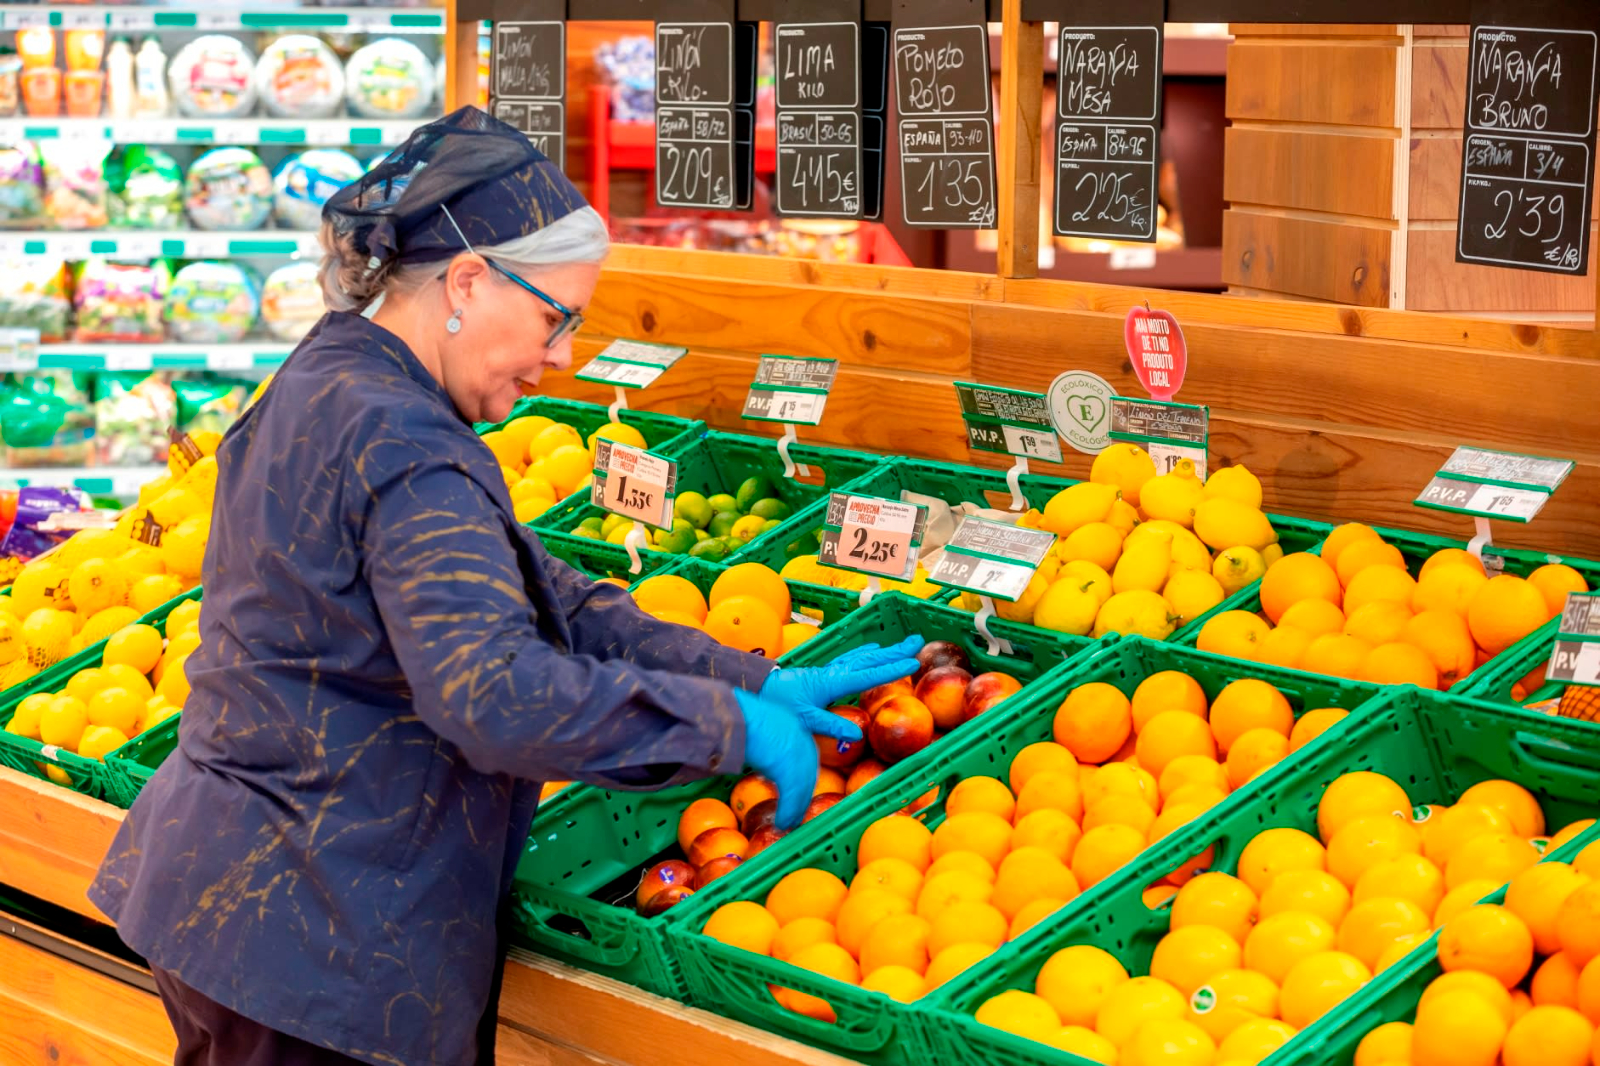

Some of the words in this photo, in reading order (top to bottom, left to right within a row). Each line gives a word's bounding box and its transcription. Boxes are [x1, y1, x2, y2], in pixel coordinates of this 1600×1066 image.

[784, 43, 835, 80] LIMA
[1064, 38, 1139, 88] NARANJA
[1478, 36, 1562, 101] NARANJA
[797, 81, 825, 99] KILO
[908, 77, 956, 113] ROJO
[1068, 80, 1111, 114] MESA
[1476, 93, 1548, 130] BRUNO
[780, 122, 815, 143] BRASIL
[820, 123, 853, 143] 50-65
[903, 130, 941, 147] ESPAÑA
[1108, 134, 1147, 156] 84-96
[1533, 151, 1564, 179] 3/4
[917, 159, 983, 211] 1'35
[1072, 172, 1133, 222] 2'25
[1484, 188, 1565, 243] 2'39
[1141, 335, 1152, 351] DE
[1158, 336, 1170, 352] NO
[1142, 353, 1174, 370] PRODUTO
[1149, 370, 1170, 387] LOCAL
[1079, 404, 1094, 421] E
[970, 427, 1003, 444] P.V.P.
[616, 475, 653, 510] 1,35€
[1426, 486, 1466, 503] P.V.P.
[848, 527, 898, 562] 2,25€
[939, 559, 968, 578] P.V.P.
